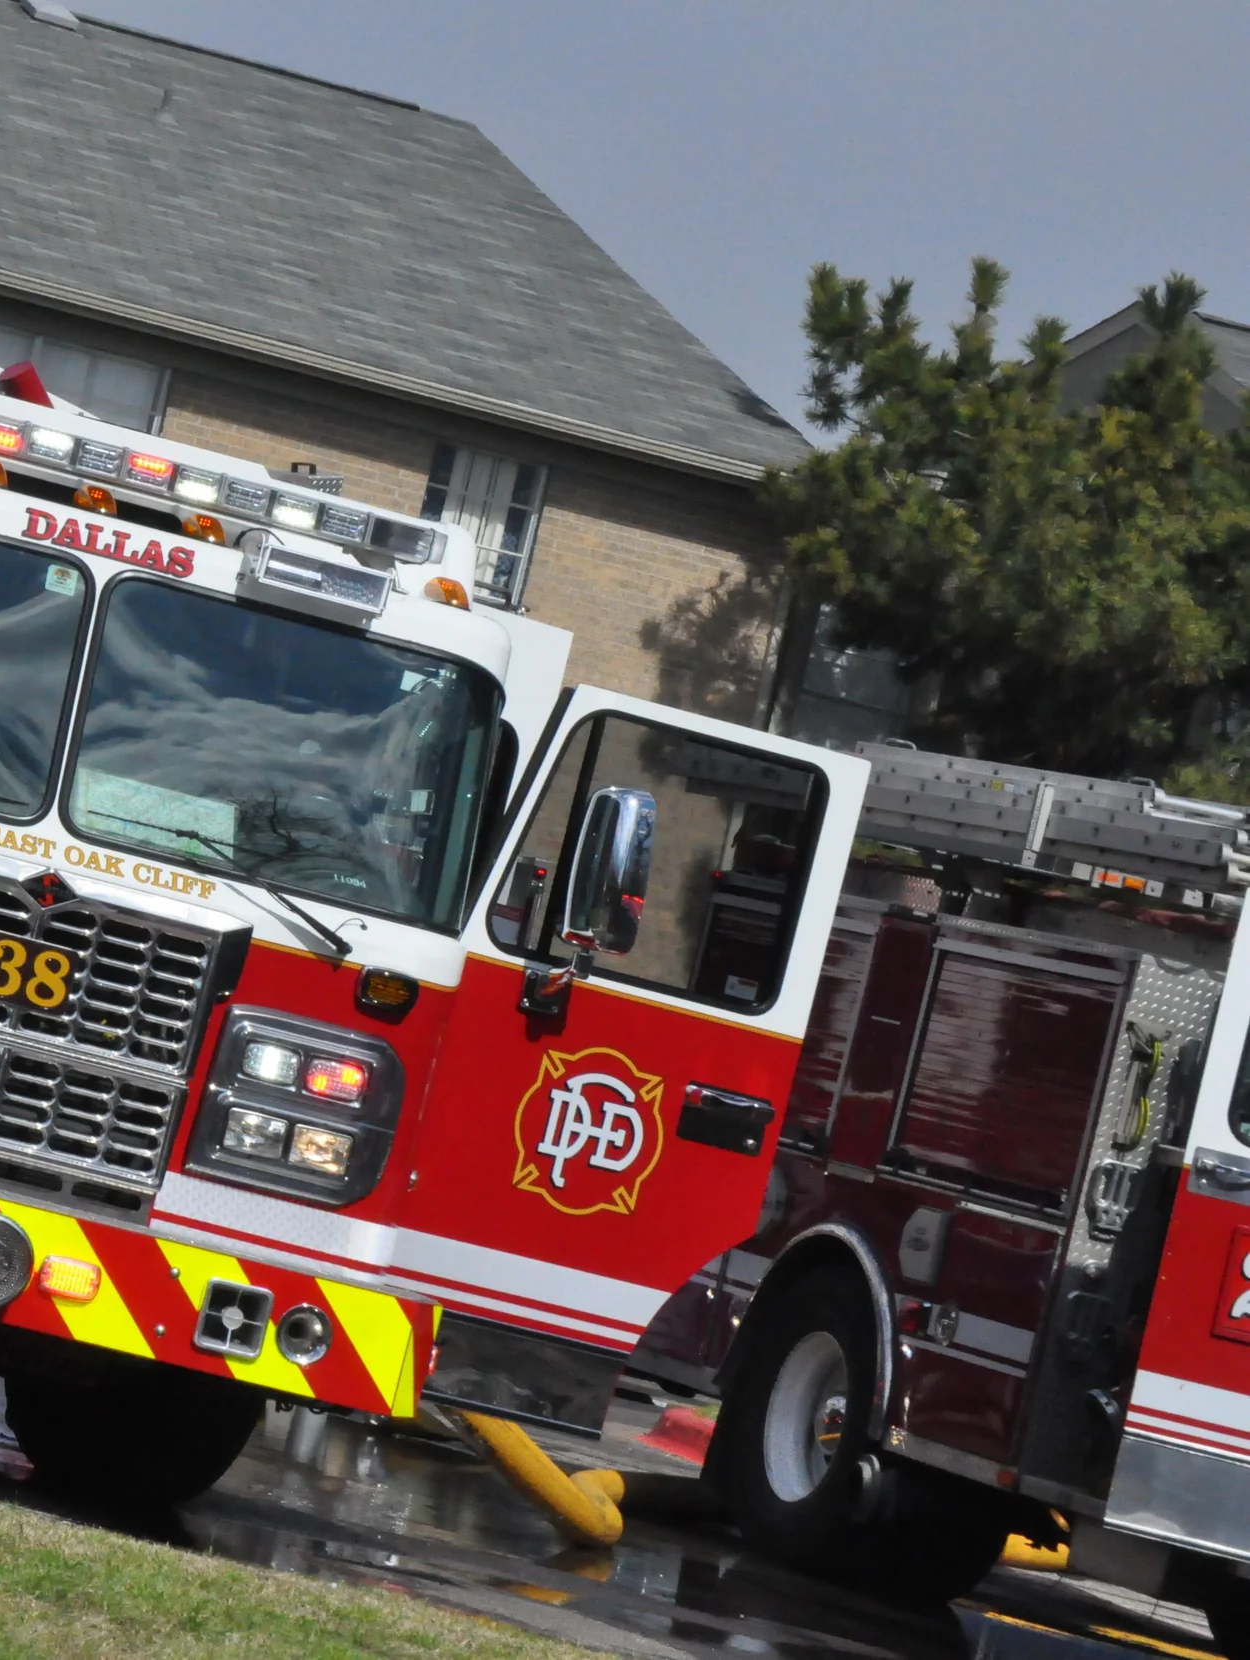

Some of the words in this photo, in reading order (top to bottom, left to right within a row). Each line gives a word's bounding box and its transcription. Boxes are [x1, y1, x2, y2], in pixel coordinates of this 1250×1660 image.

[21, 507, 196, 578] DALLAS
[63, 846, 126, 878] OAK
[132, 862, 217, 900] CLIFF
